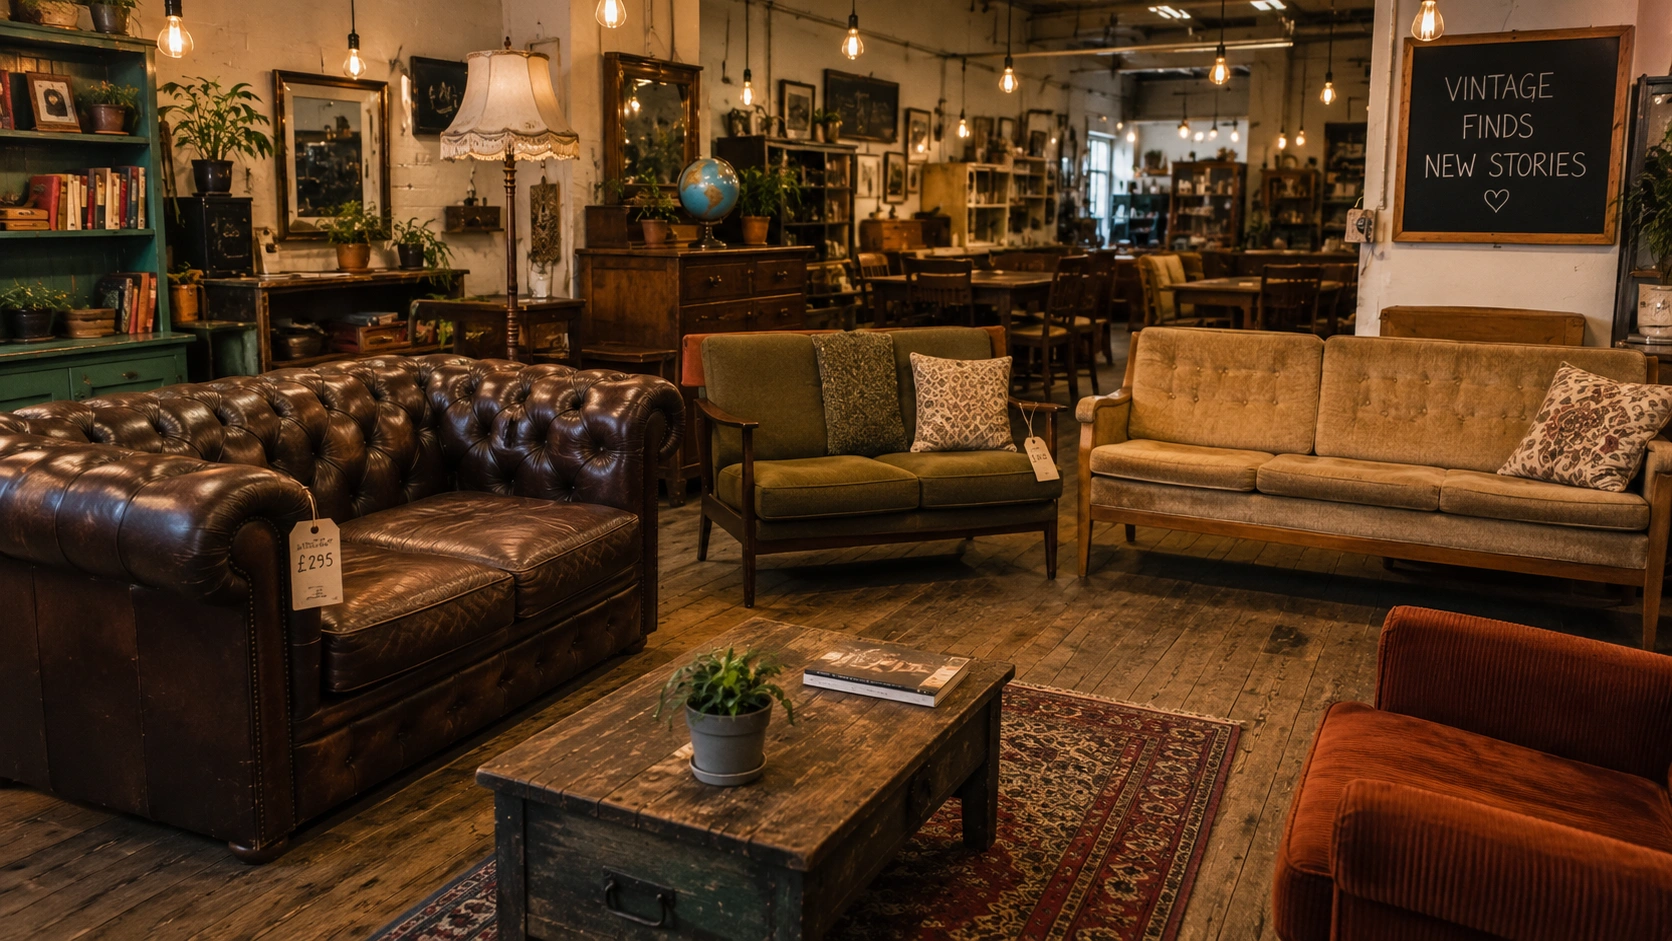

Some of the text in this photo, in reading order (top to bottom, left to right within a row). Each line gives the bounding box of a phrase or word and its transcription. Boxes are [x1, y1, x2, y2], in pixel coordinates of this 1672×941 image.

[1445, 72, 1554, 102] VINTAGE
[1462, 113, 1534, 139] FINDS
[1425, 151, 1587, 178] NEW STORIES
[297, 552, 334, 573] £295
